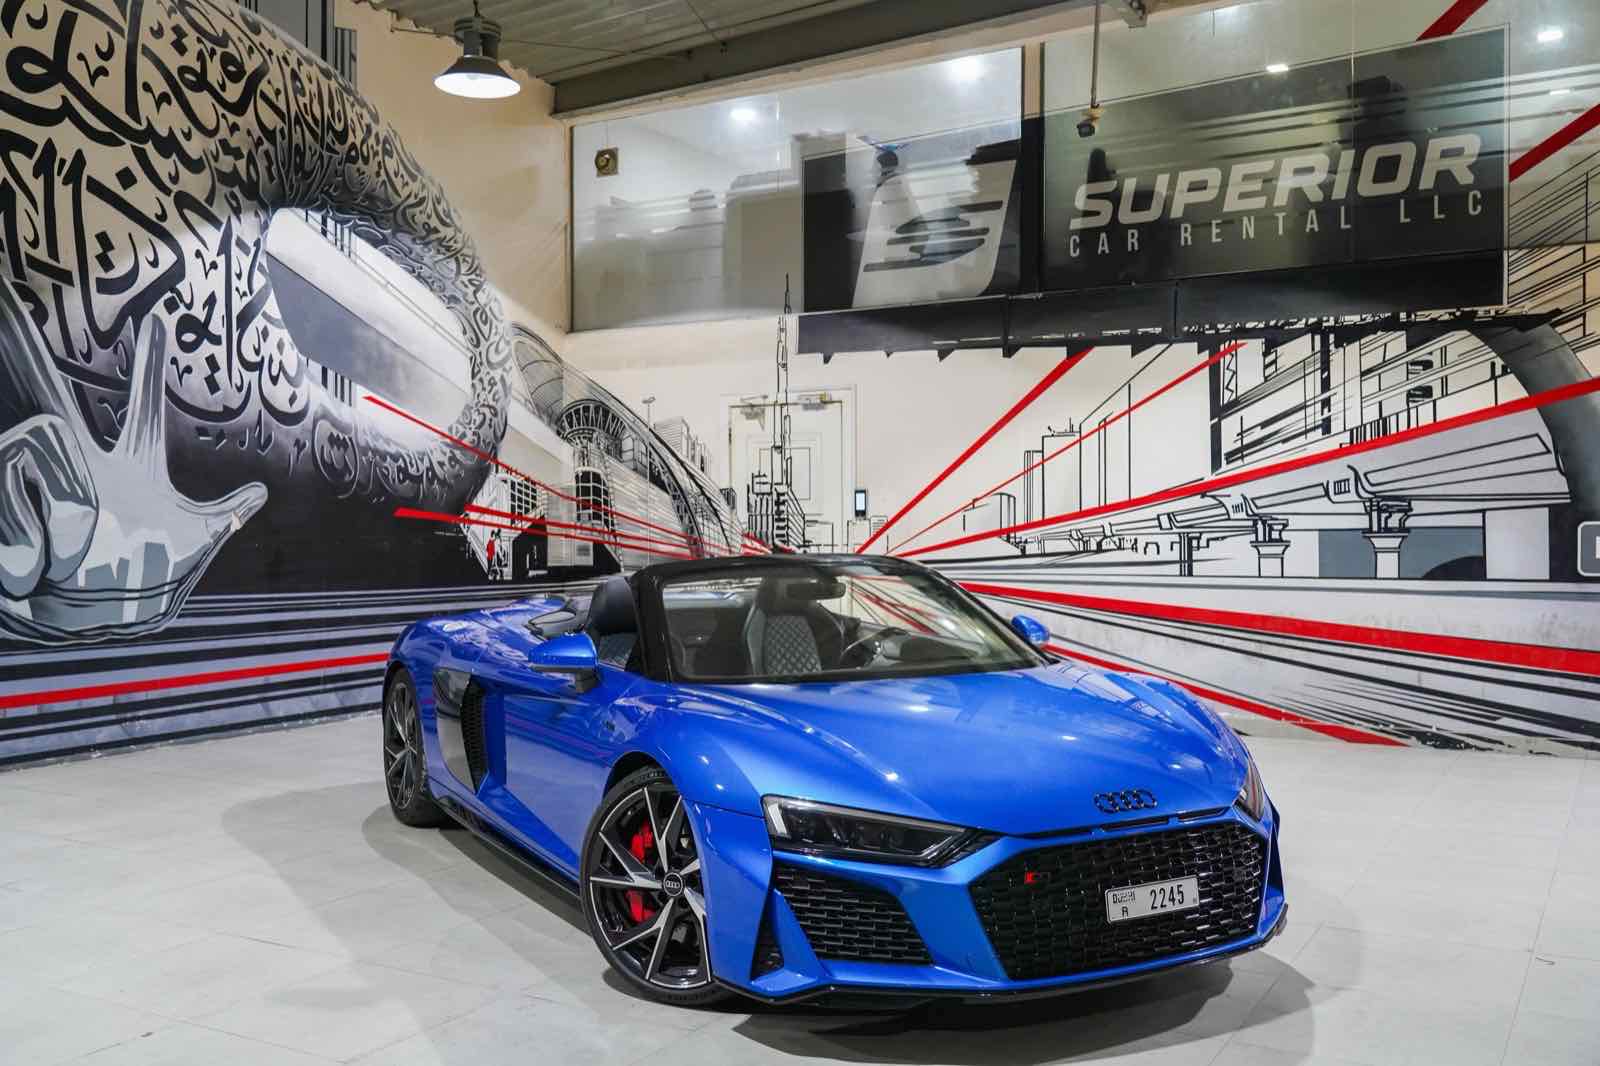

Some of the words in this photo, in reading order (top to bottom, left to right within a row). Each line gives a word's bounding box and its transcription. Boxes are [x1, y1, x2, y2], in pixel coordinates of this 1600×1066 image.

[1069, 133, 1481, 230] SUPERIOR
[1069, 228, 1139, 257] CAR
[1180, 205, 1352, 247] RENTAL
[1400, 190, 1482, 223] LLC
[1150, 884, 1184, 910] 2245
